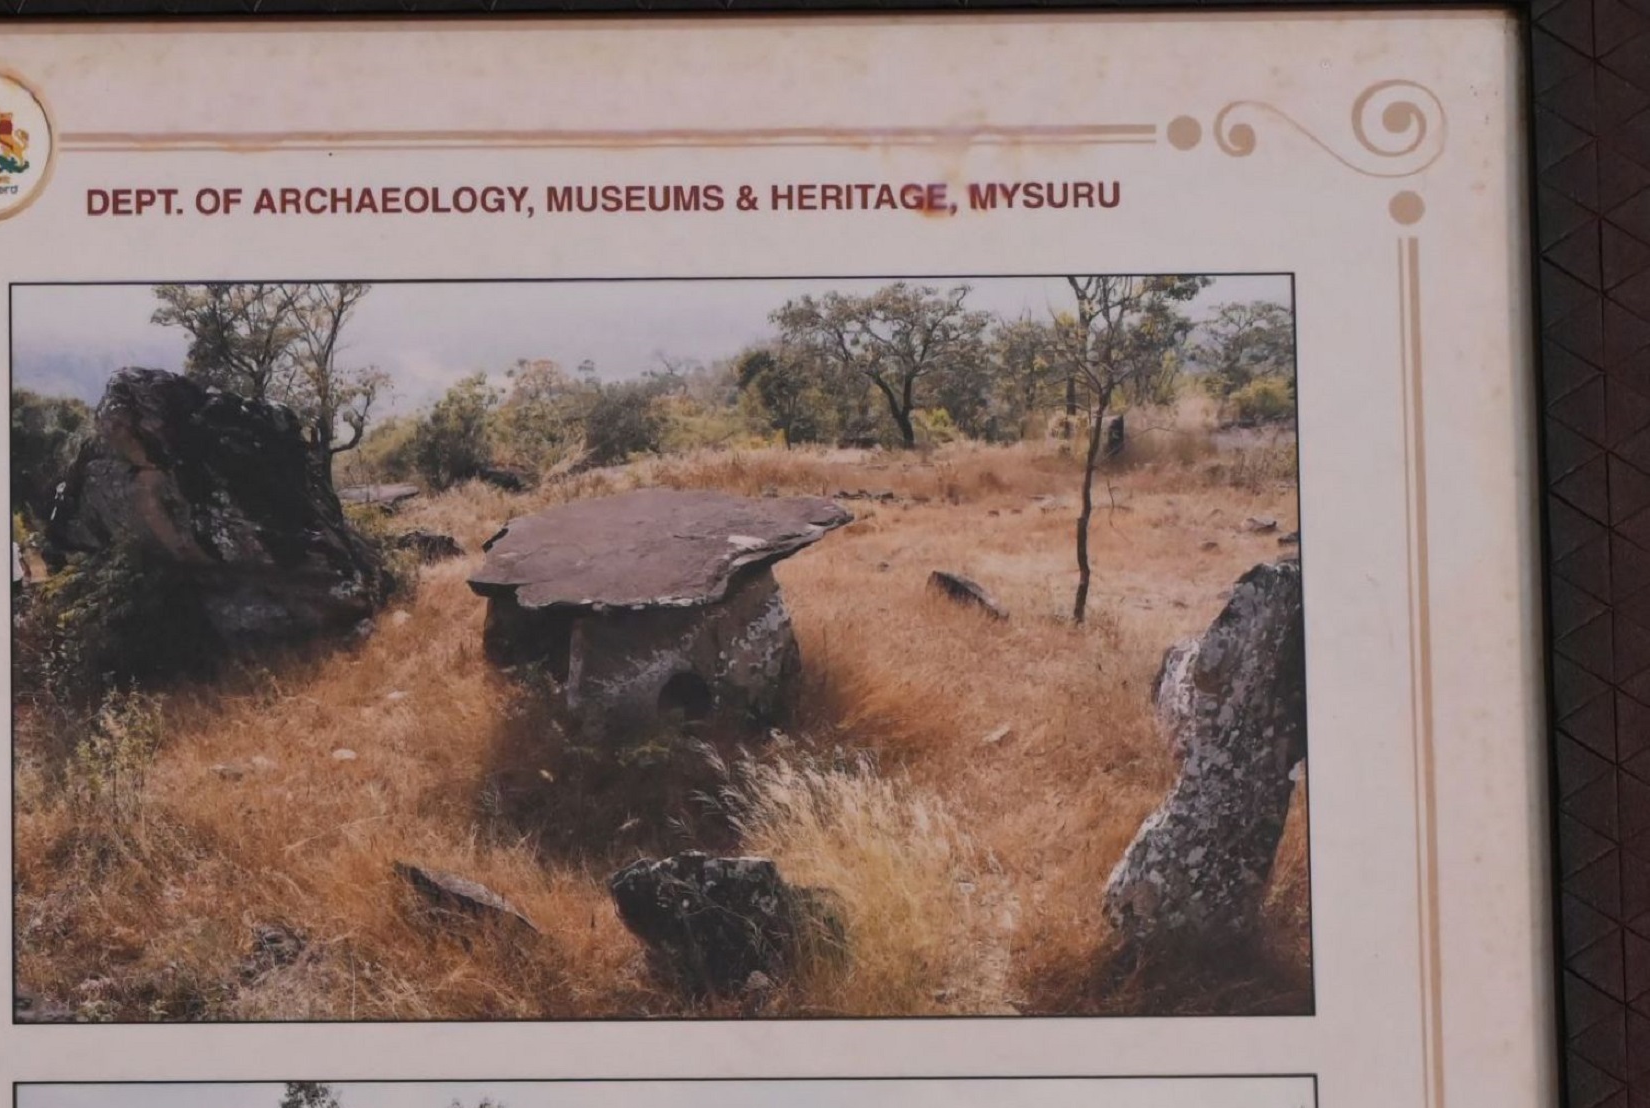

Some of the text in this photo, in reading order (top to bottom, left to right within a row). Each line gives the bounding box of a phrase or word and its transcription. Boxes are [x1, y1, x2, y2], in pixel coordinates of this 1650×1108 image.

[86, 180, 1121, 218] DEPT. OF ARCHAEOLOGY, MUSEUMS & HERITAGE, MYSURU
